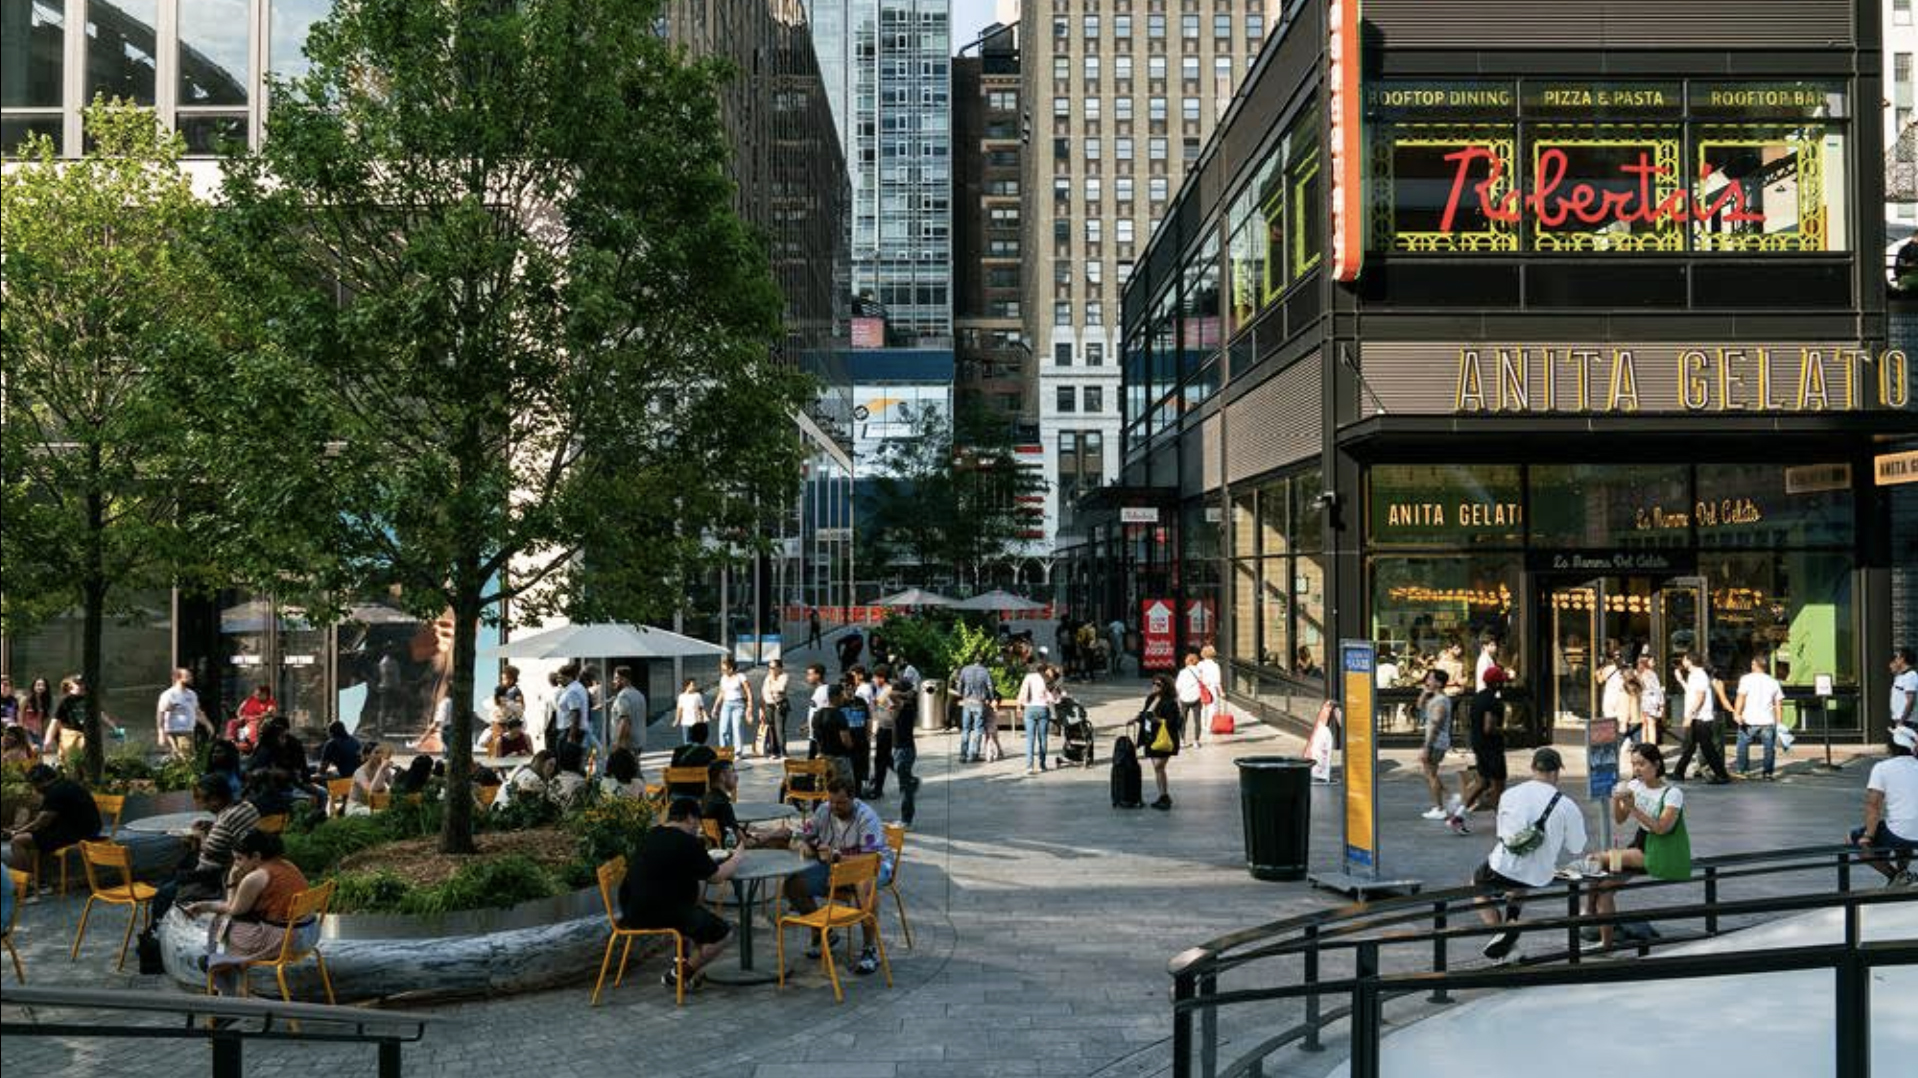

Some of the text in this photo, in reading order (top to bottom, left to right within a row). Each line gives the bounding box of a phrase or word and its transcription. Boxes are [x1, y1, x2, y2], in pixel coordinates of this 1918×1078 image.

[1449, 90, 1510, 106] DINING
[1543, 90, 1592, 106] PIZZA
[1614, 90, 1664, 106] PASTA
[1710, 90, 1827, 106] ROOFTOP BAR
[1439, 145, 1767, 234] Roberta's
[1455, 347, 1909, 412] ANITA GELATO
[1388, 503, 1445, 526] ANITA
